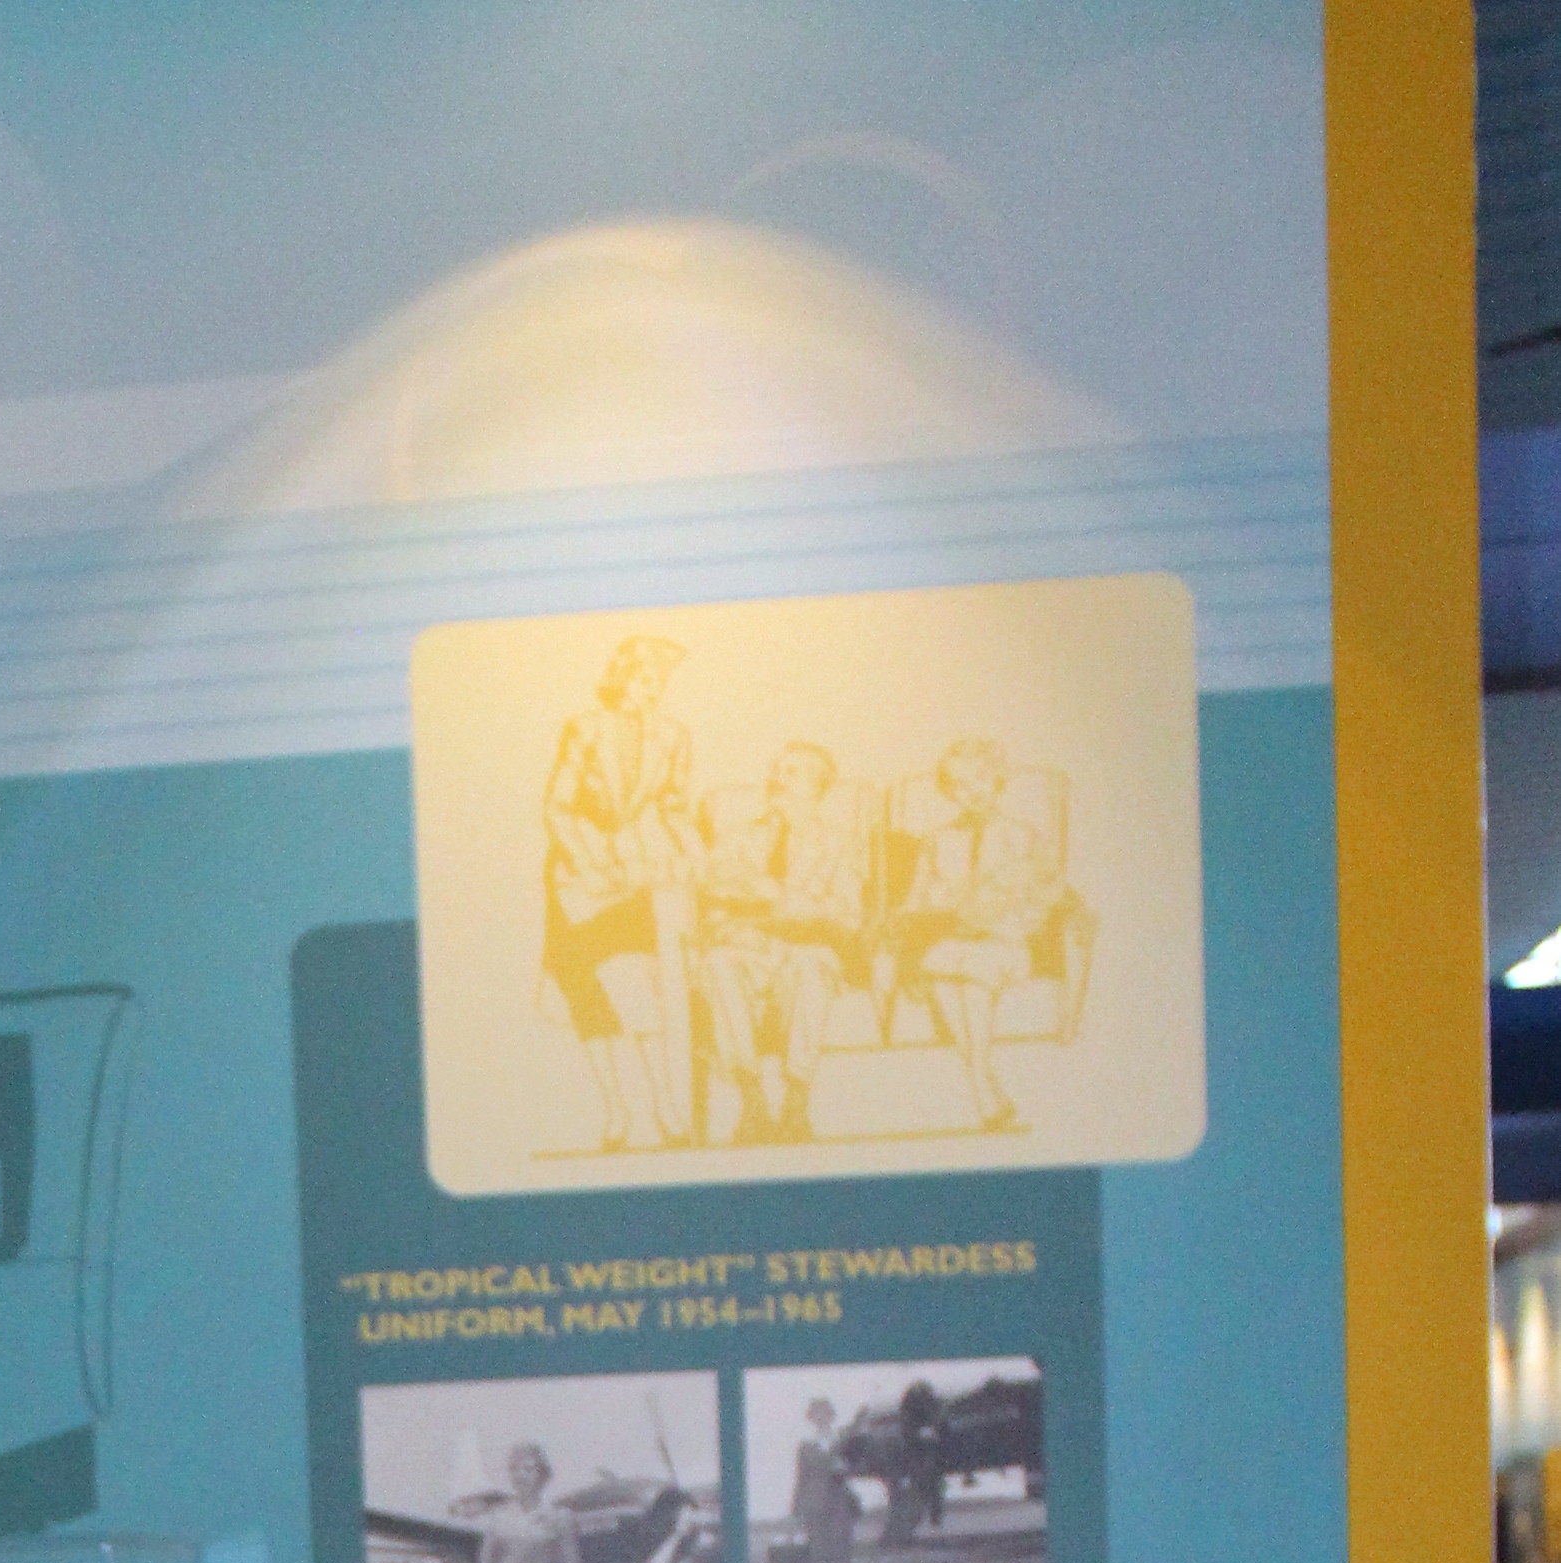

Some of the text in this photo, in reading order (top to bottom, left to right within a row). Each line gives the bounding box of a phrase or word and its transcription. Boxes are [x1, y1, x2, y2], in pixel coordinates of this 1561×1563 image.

[767, 1241, 1037, 1282] STEWARDESS
[360, 1303, 555, 1342] UNIFORM,
[561, 1300, 645, 1332] MAY
